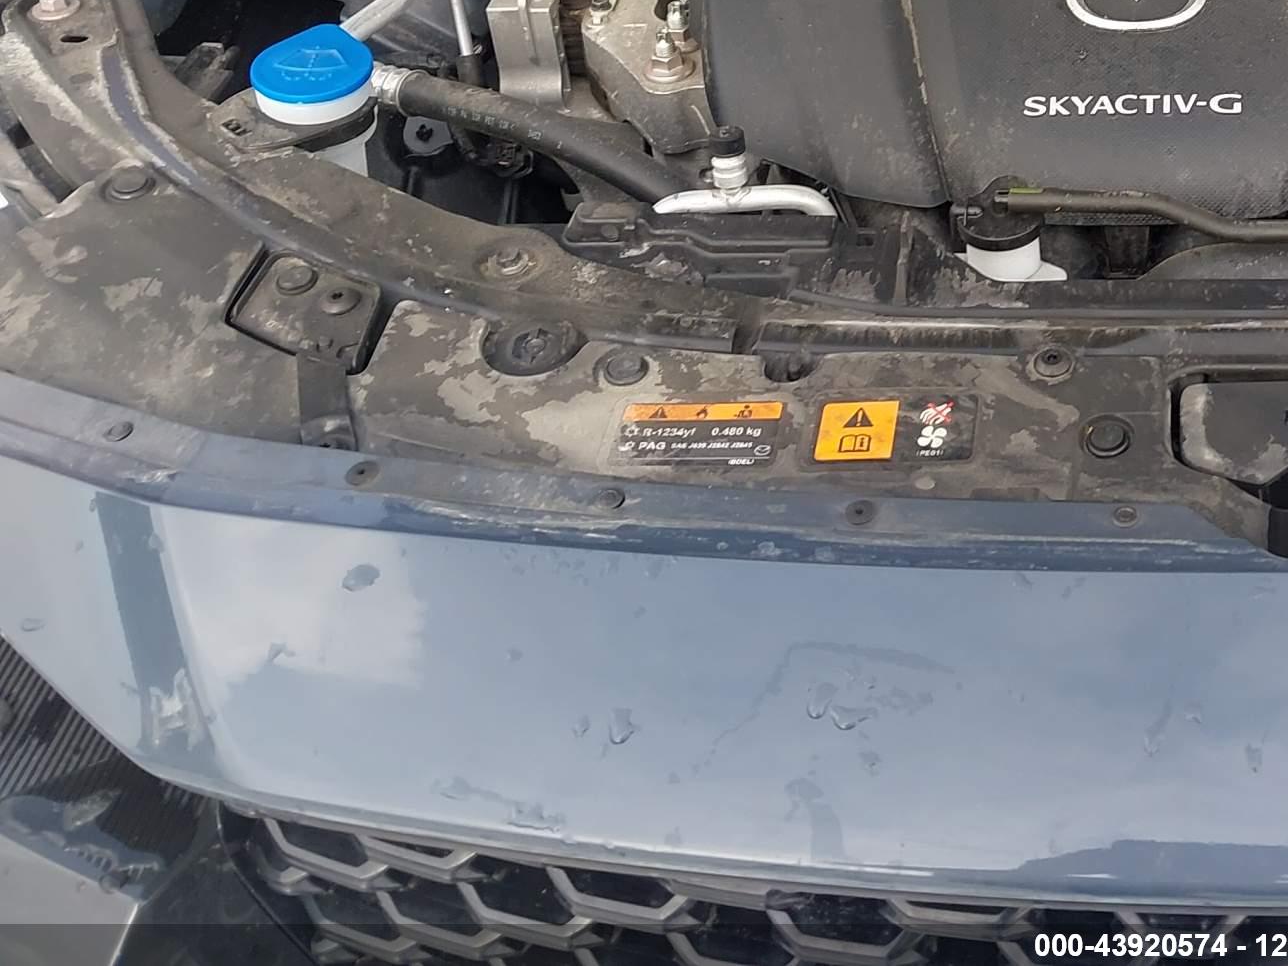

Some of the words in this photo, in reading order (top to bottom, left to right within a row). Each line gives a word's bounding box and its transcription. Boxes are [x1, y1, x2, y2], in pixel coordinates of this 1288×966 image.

[1022, 92, 1243, 117] SKYACTIV-G
[642, 426, 697, 438] R-1234yf
[711, 426, 743, 436] 0.480
[746, 426, 762, 438] kg
[638, 441, 666, 451] PAG
